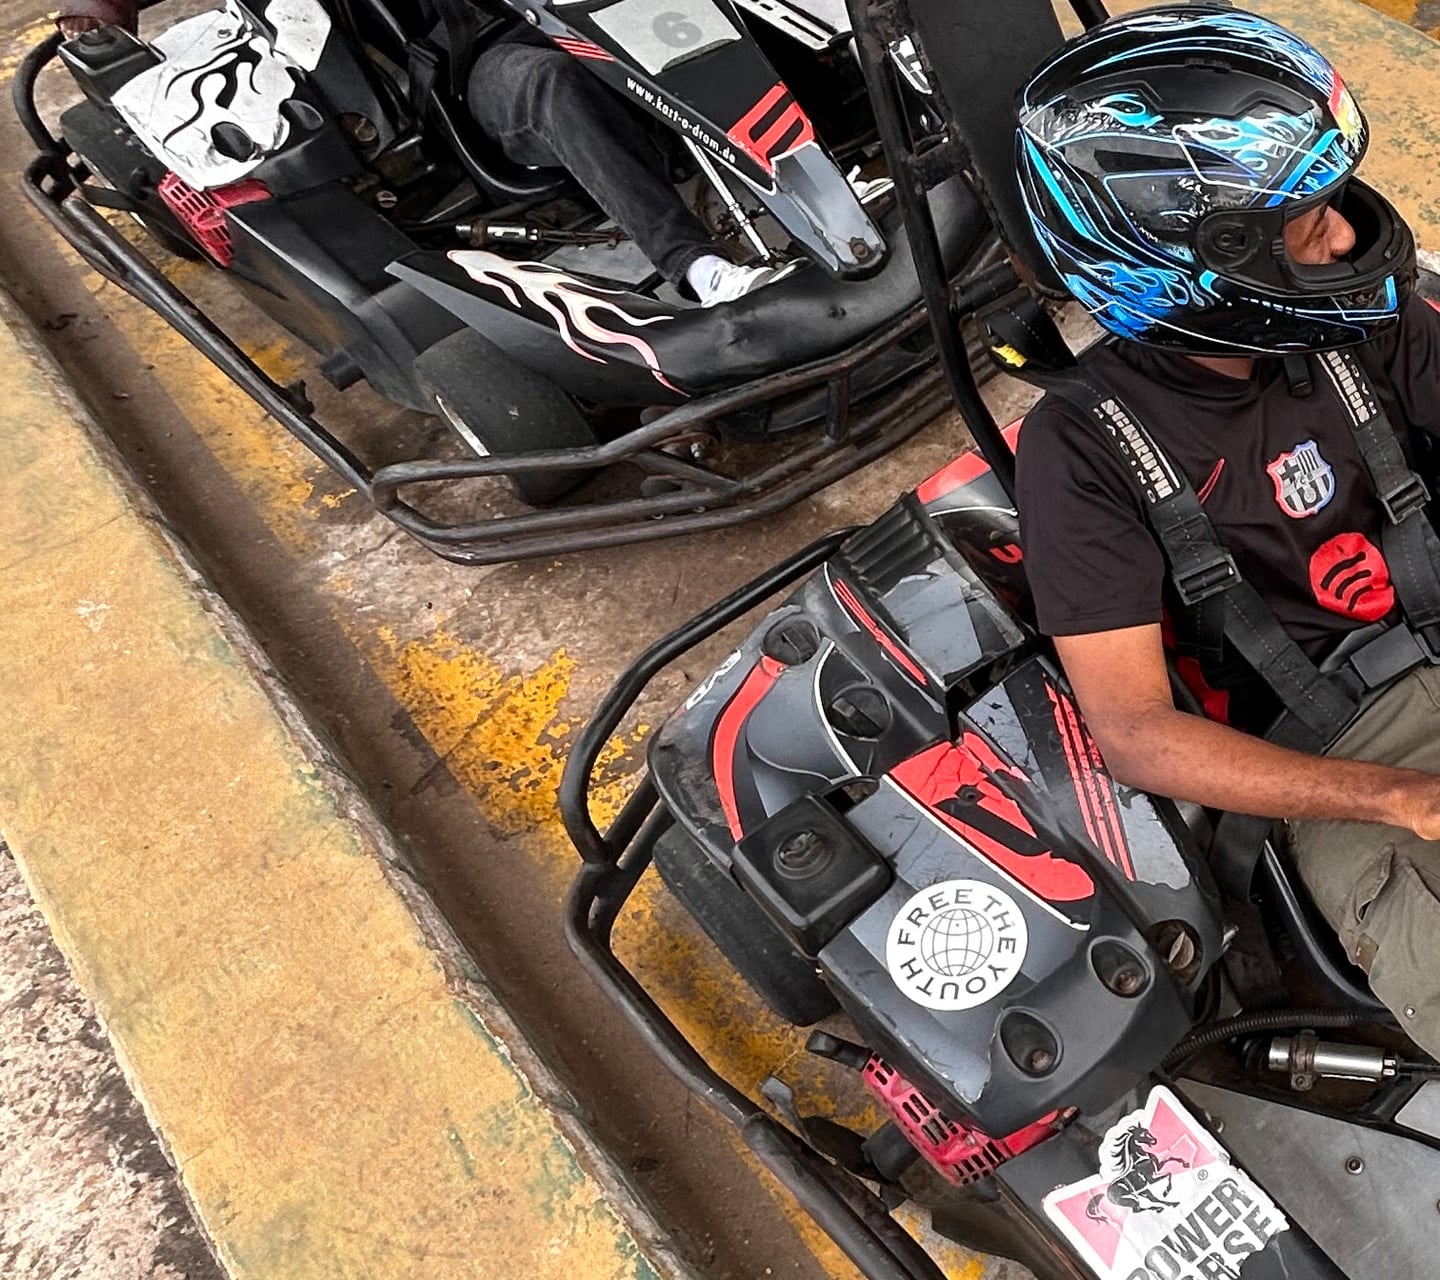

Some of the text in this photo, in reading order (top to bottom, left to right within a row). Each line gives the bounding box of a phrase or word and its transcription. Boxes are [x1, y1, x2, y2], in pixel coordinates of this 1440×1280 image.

[651, 11, 703, 49] 6
[625, 76, 737, 164] www.kart-o-drom.de
[1325, 349, 1371, 423] SCHRO
[896, 888, 1017, 1000] FREE THE YOUTH
